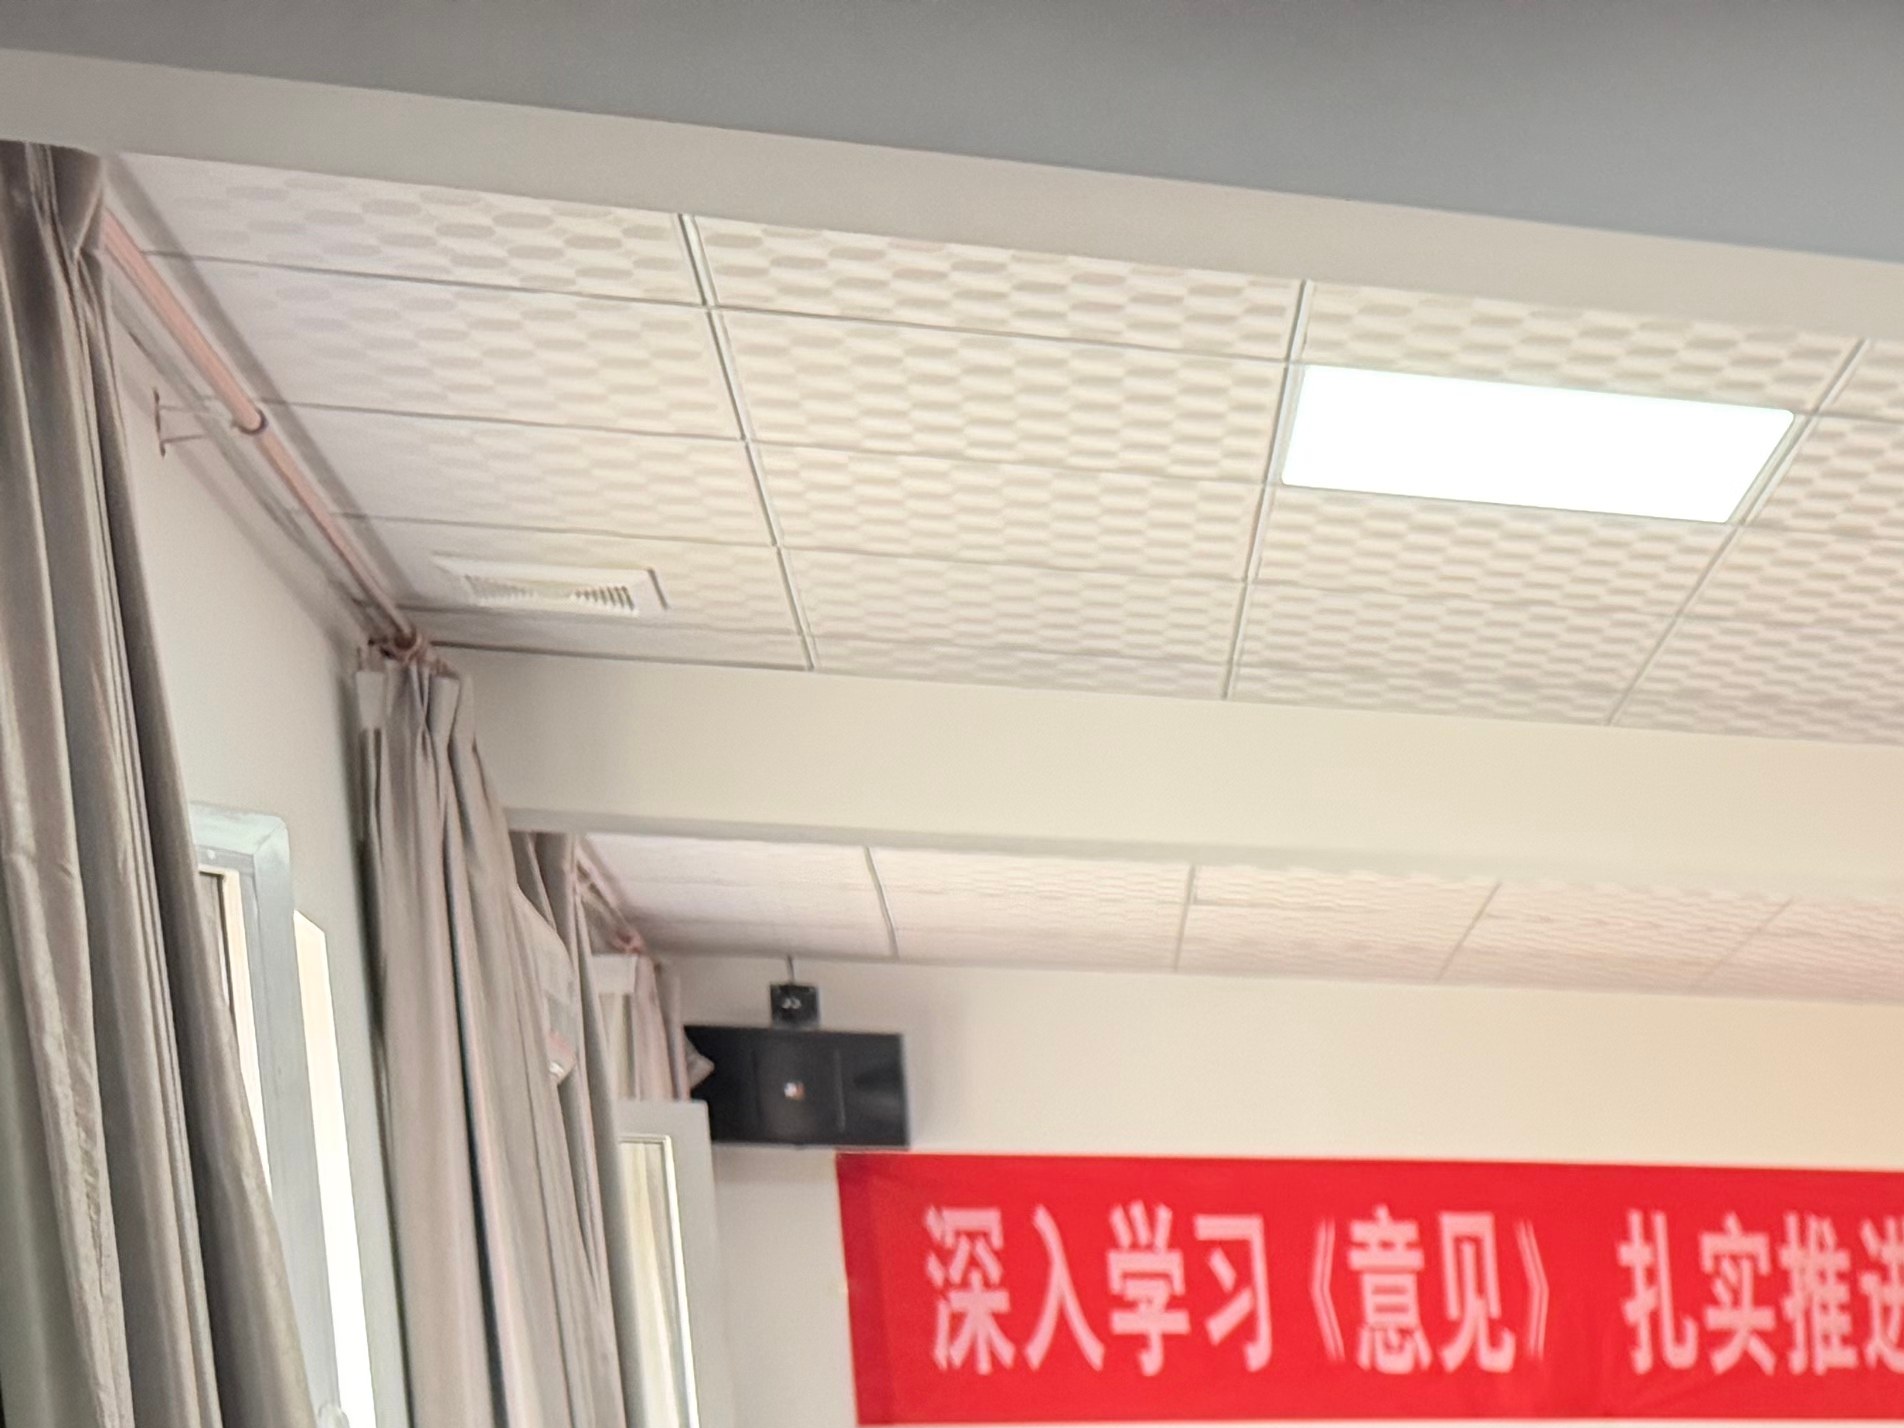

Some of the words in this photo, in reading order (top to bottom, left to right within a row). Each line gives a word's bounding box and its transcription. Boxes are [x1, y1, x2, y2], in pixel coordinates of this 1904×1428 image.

[924, 1200, 1549, 1376] 深入学习《意见》
